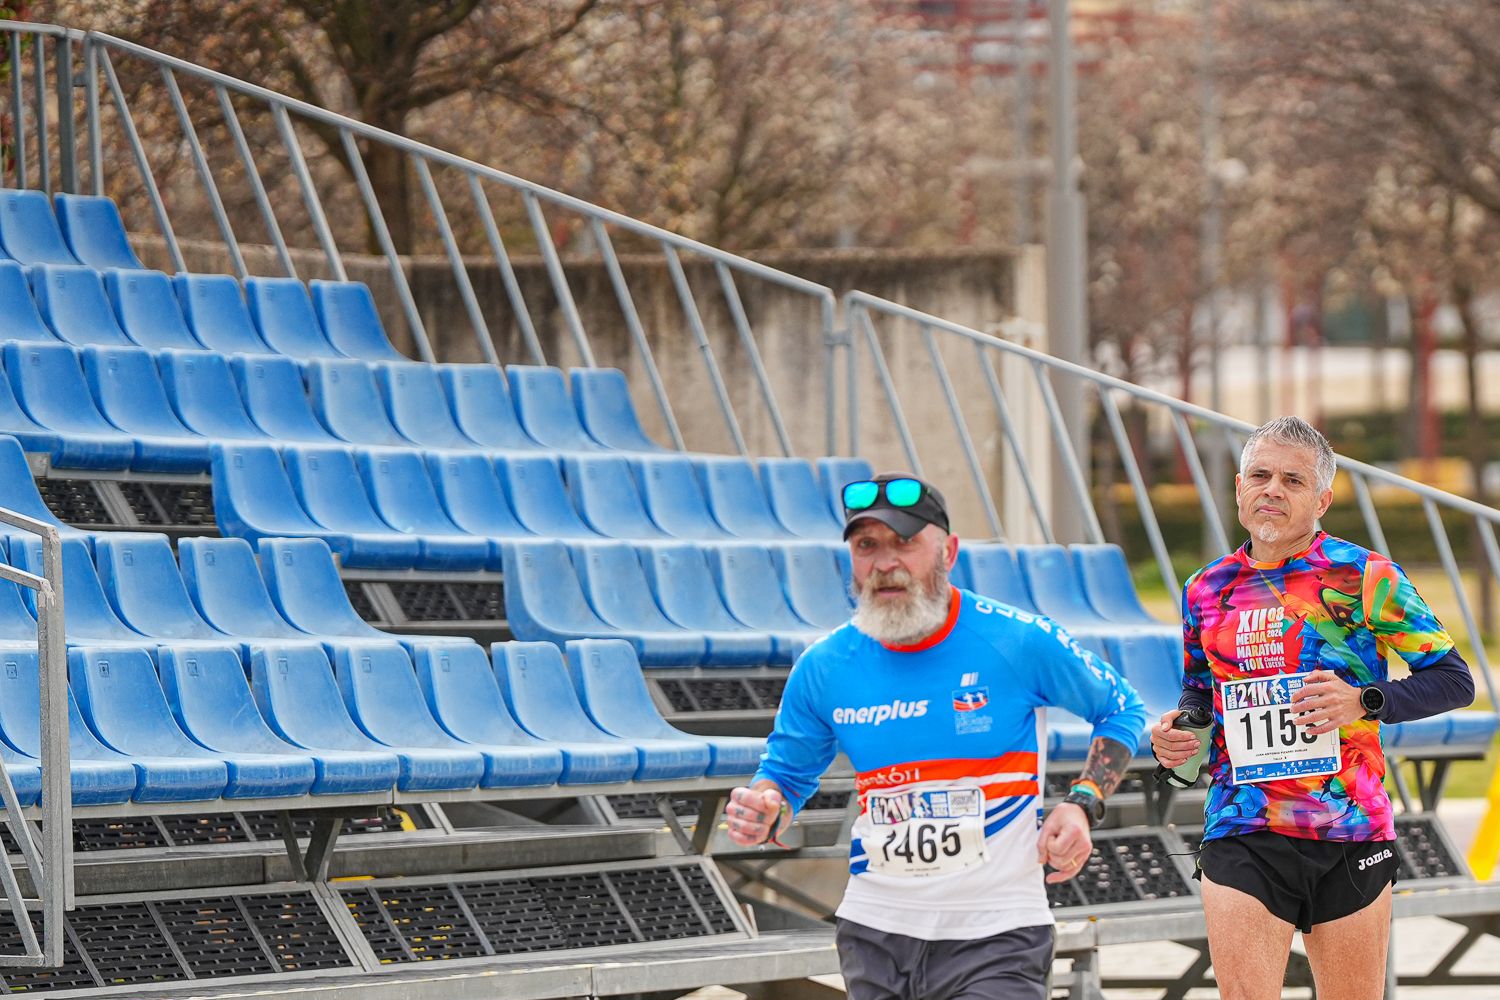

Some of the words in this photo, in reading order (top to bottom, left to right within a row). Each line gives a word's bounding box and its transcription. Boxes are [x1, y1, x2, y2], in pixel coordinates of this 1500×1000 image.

[1237, 608, 1267, 633] XII
[1267, 607, 1284, 622] 08
[1236, 631, 1267, 646] MEDIA
[1236, 640, 1284, 659] MARATÓN
[1245, 657, 1265, 671] 10K
[1237, 681, 1271, 708] 21K
[833, 699, 929, 726] enerplus
